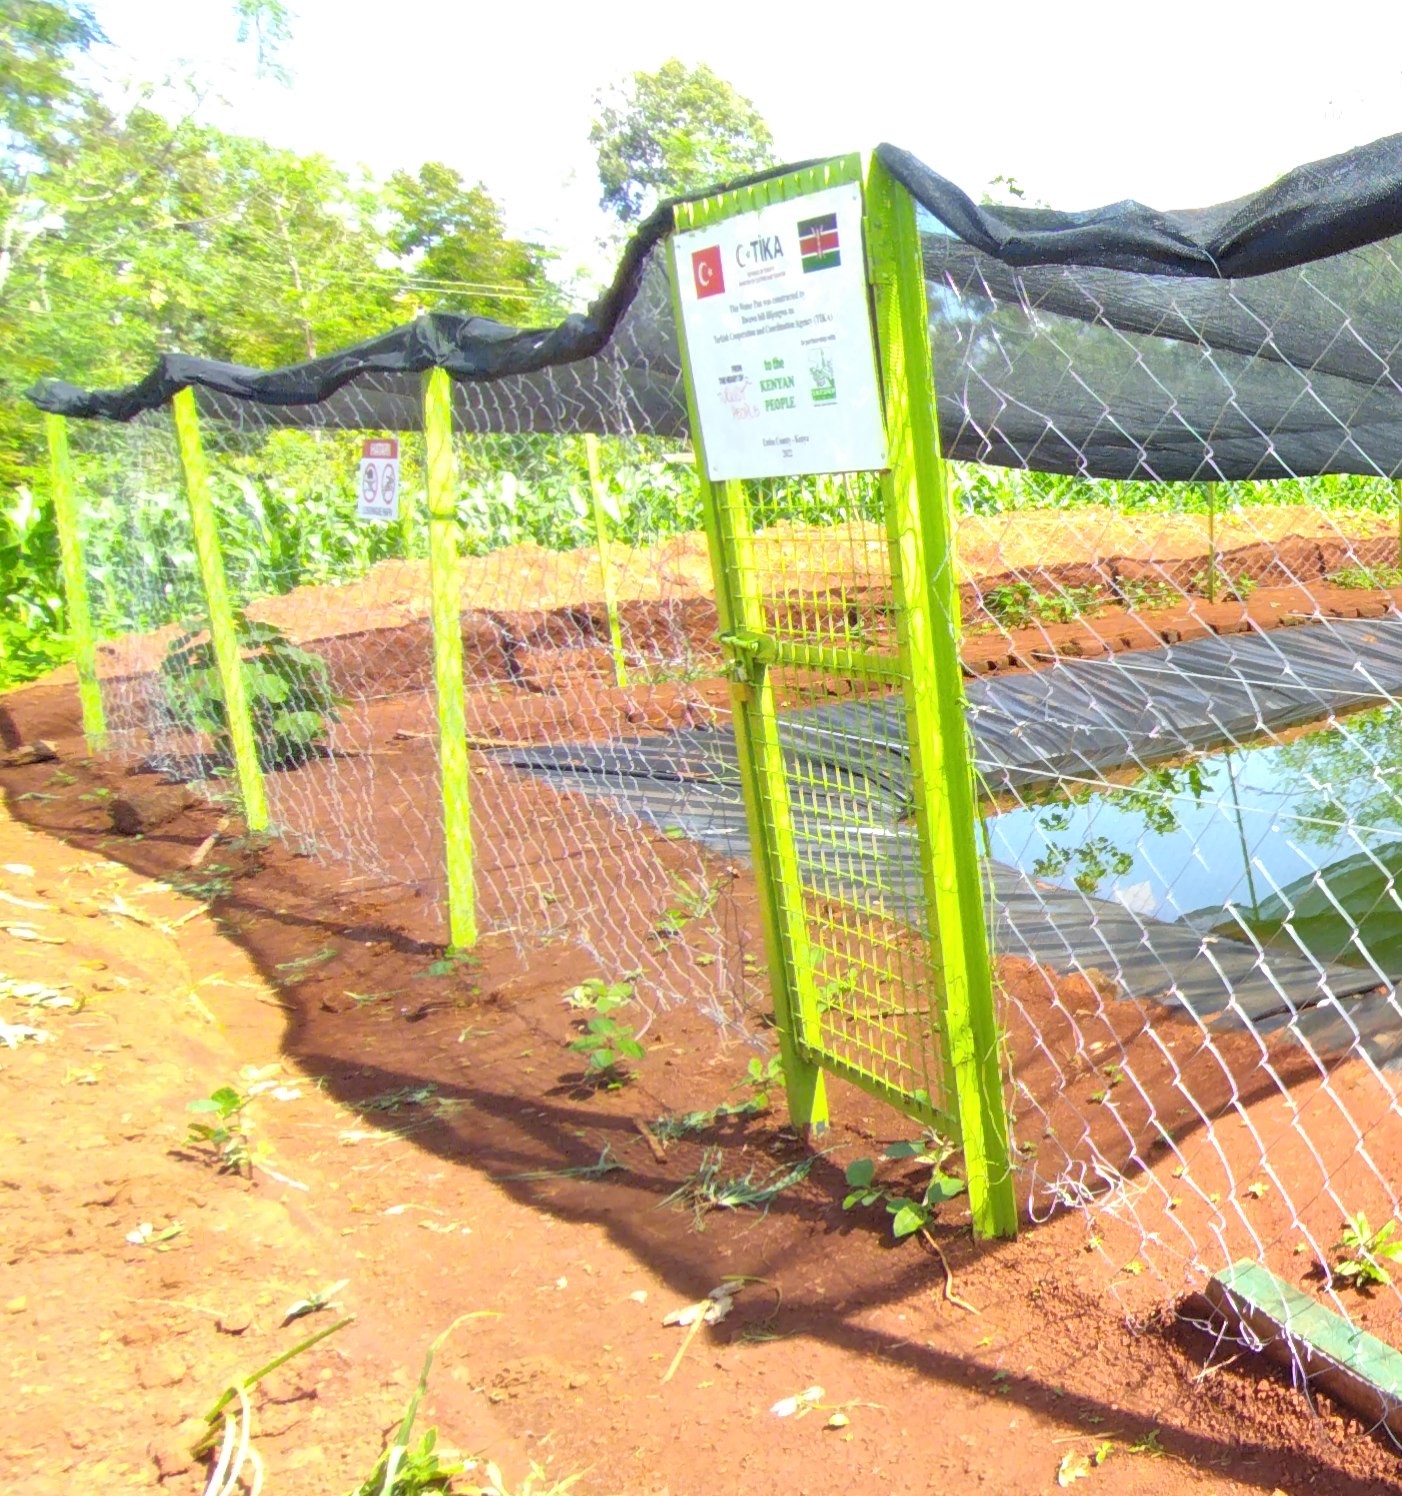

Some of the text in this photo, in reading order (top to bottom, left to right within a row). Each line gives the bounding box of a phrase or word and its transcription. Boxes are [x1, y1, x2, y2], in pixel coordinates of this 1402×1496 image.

[764, 356, 784, 371] to the
[760, 376, 795, 392] KENYAN
[765, 396, 796, 412] PEOPLE
